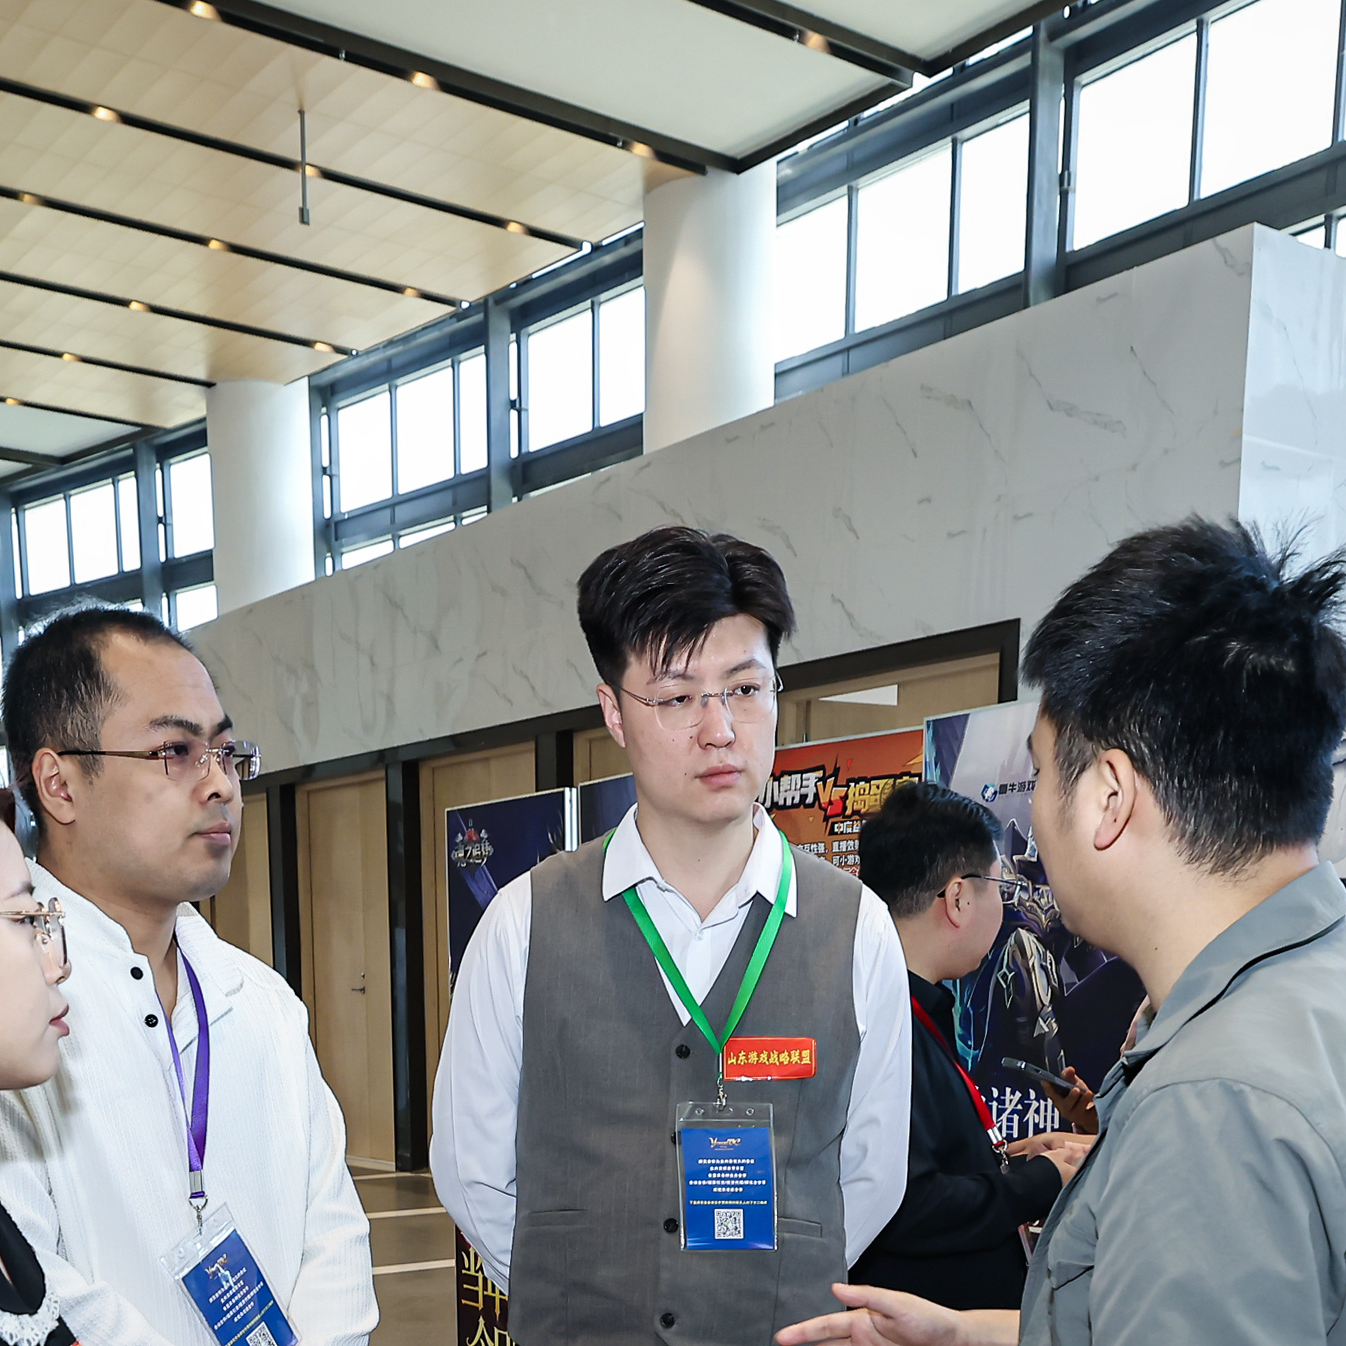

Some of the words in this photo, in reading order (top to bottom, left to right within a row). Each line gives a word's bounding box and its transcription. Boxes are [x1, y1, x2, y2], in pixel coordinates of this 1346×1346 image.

[756, 770, 919, 816] 小帮手VS捣蛋
[728, 1049, 811, 1065] 山东游戏战略联盟
[976, 1086, 1059, 1138] 诸神
